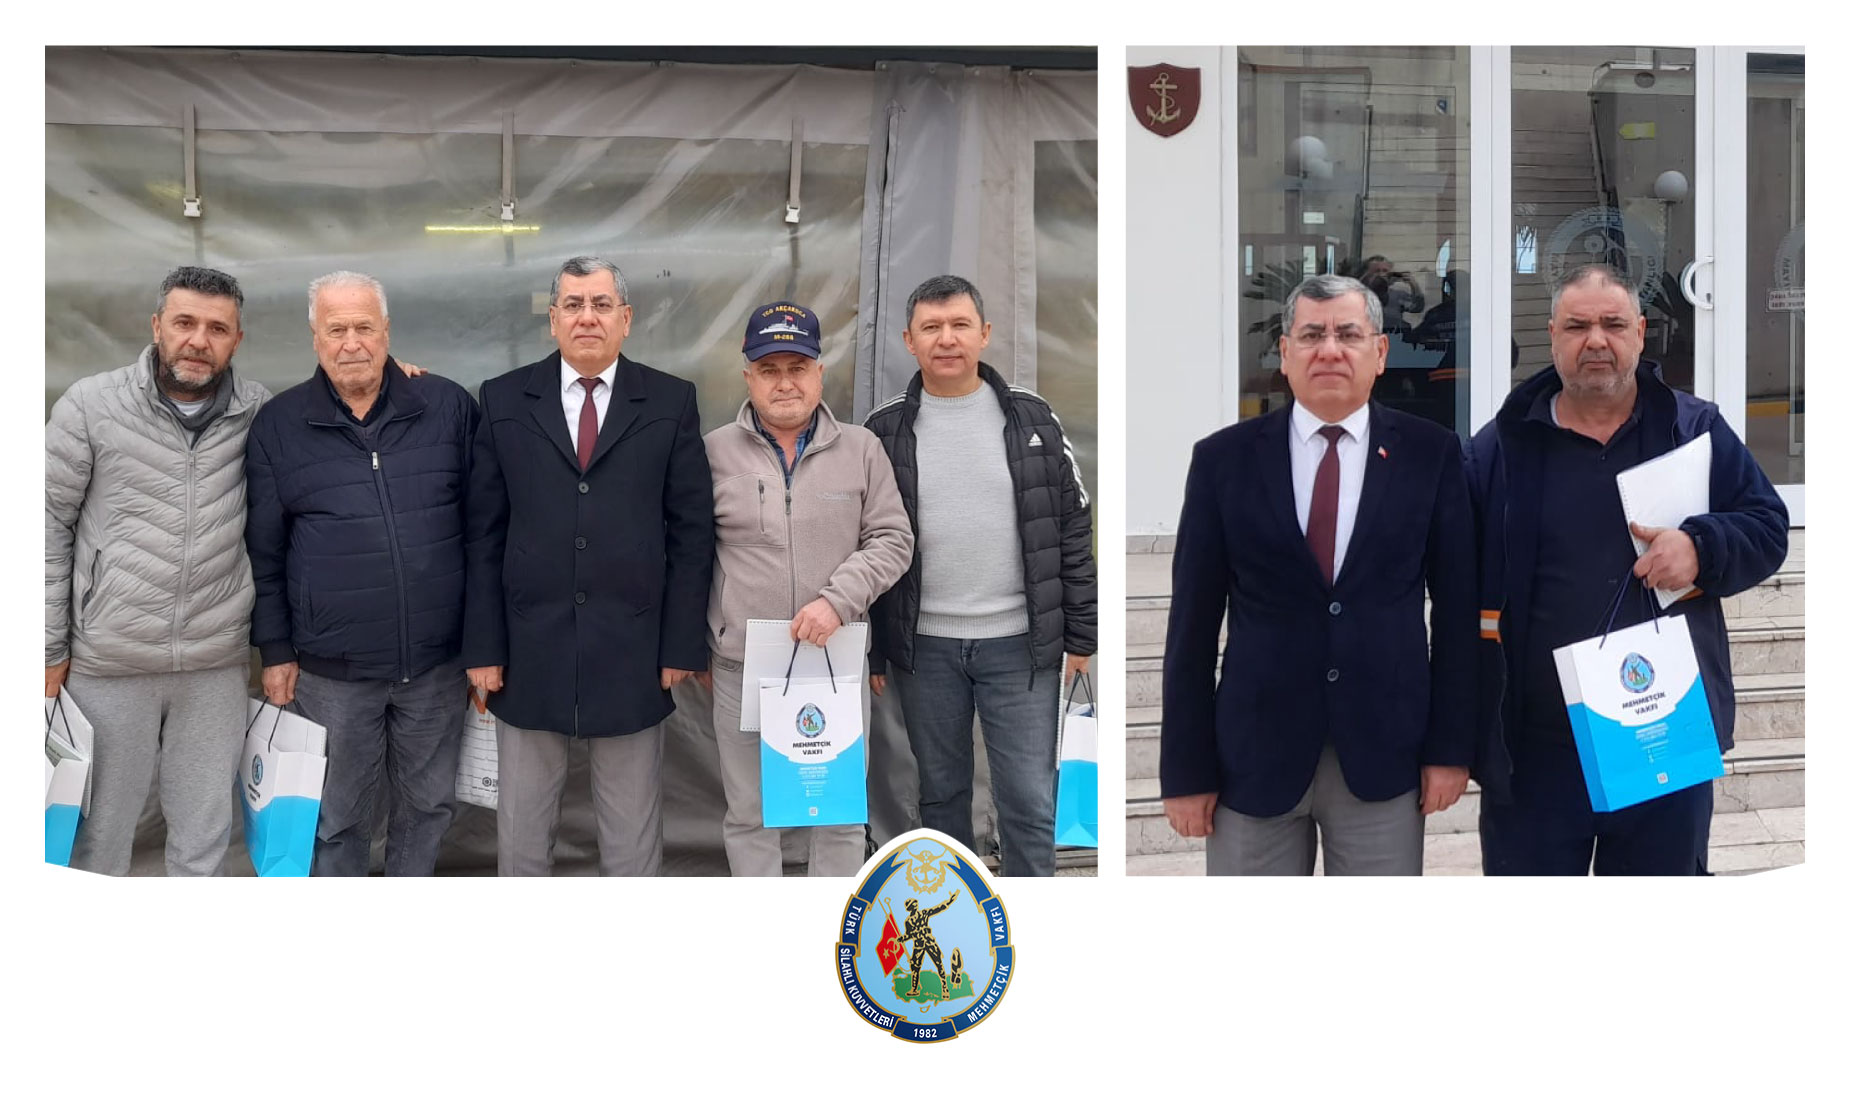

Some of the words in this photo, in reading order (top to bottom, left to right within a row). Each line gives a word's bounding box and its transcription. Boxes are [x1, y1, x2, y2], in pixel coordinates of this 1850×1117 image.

[1622, 692, 1666, 710] MEHMETÇİK
[1634, 703, 1658, 715] VAKFI
[792, 741, 831, 749] MEHMETÇİK
